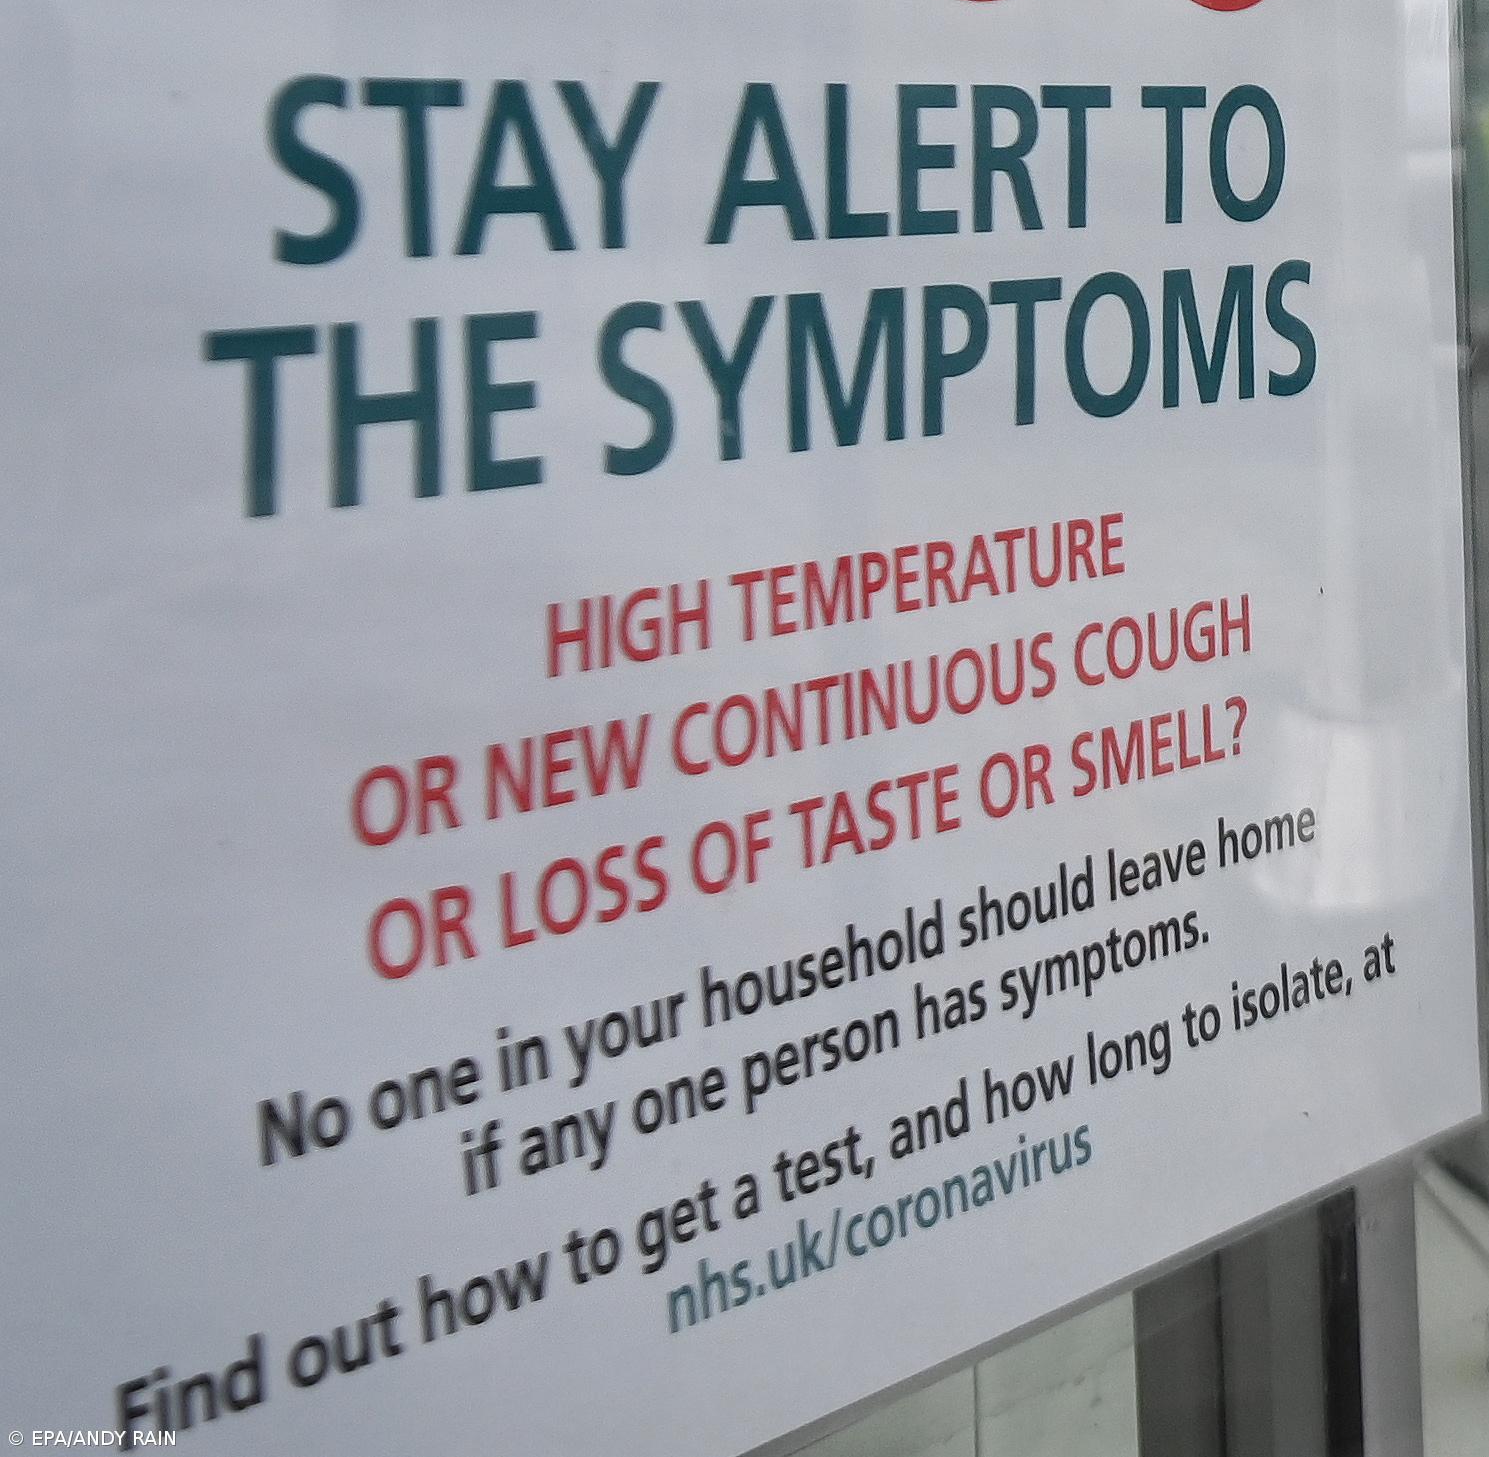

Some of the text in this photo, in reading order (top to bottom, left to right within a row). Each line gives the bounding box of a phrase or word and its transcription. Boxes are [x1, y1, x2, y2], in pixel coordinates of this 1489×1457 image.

[265, 73, 1287, 267] STAY ALERT TO
[203, 259, 1318, 520] THE SYMPTOMS
[350, 593, 1253, 848] OR NEW CONTINUOUS COUGH
[545, 513, 1126, 678] HIGH TEMPERATURE
[366, 695, 1249, 980] OR LOSS OF TASTE OR SMELL?
[257, 805, 1316, 1166] No one in your household should leave home
[460, 909, 1210, 1196] if any one person has symptoms.
[115, 931, 1396, 1452] Find out how to get a test, and how long to isolate, at
[667, 1124, 1093, 1334] nhs.uk/coronavirus
